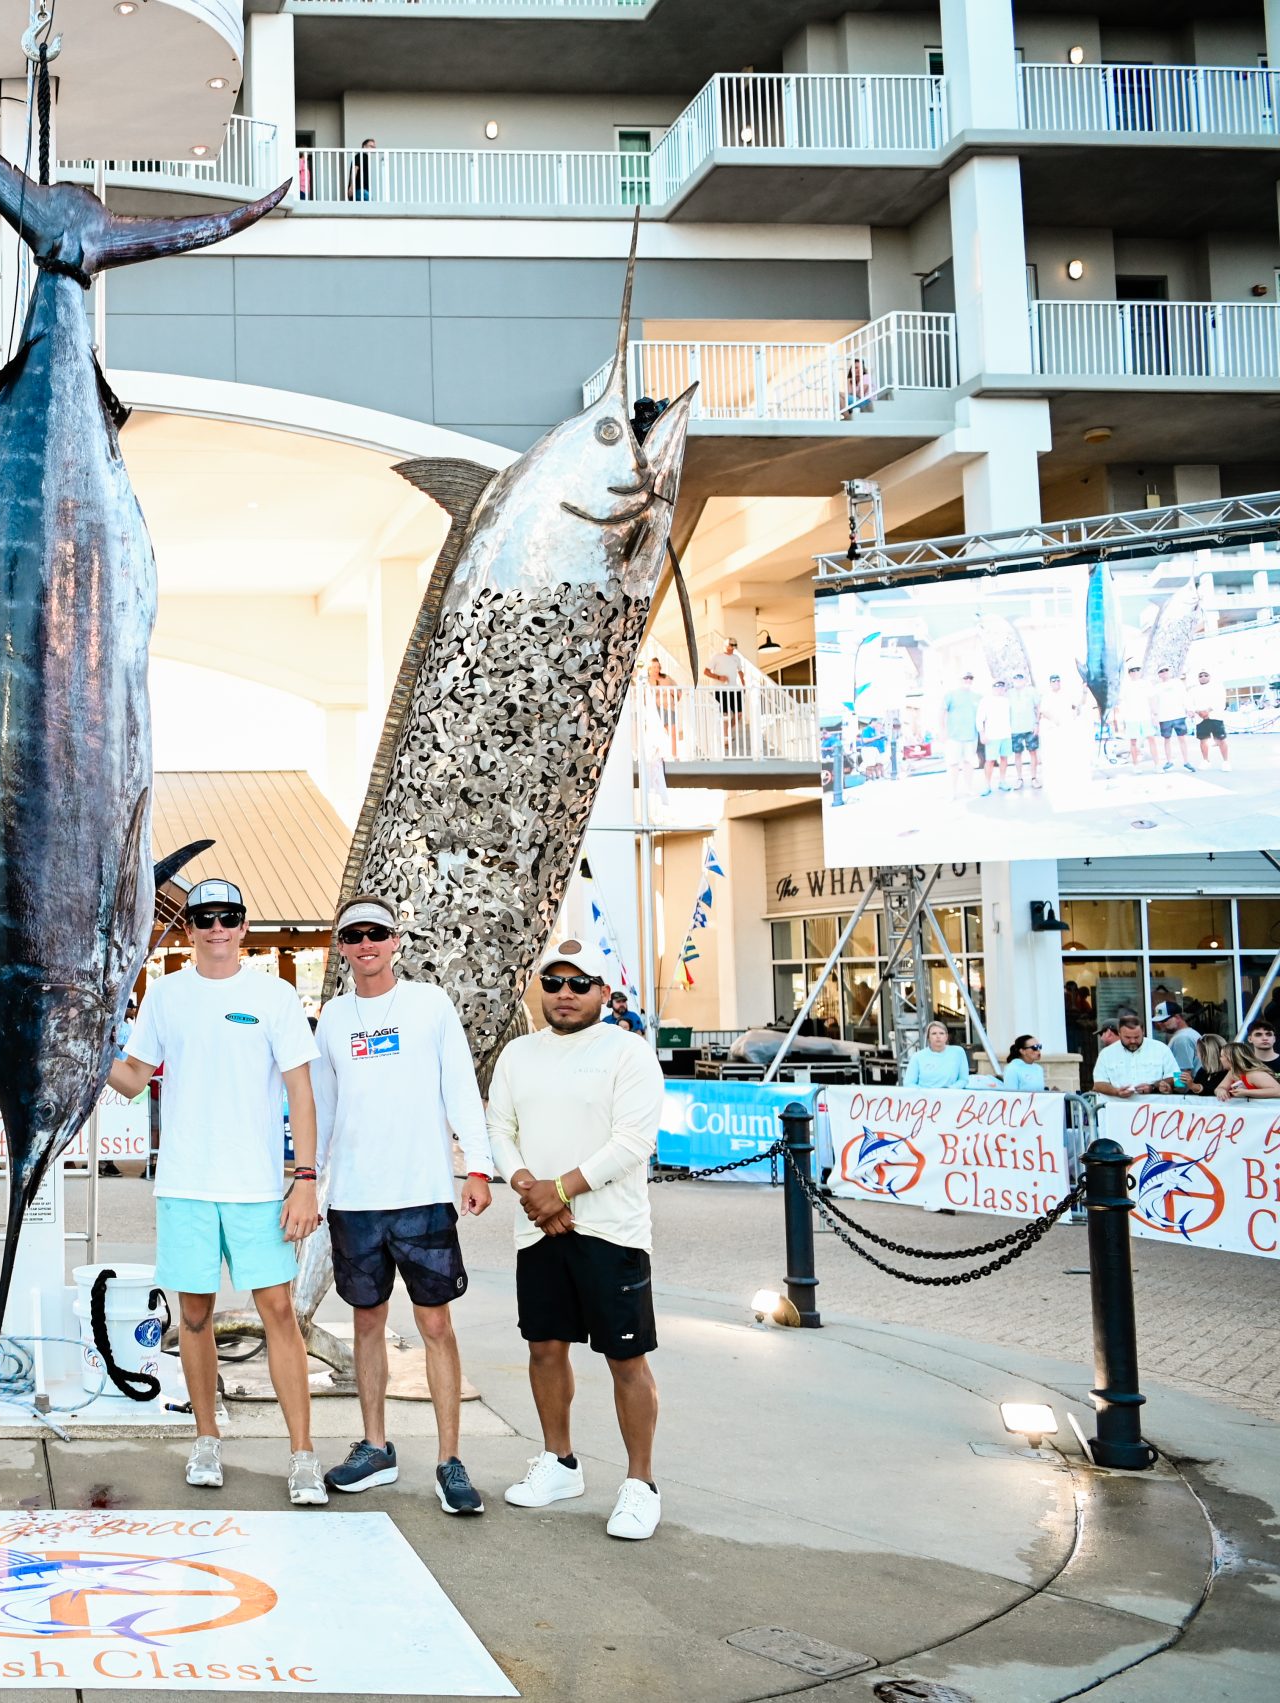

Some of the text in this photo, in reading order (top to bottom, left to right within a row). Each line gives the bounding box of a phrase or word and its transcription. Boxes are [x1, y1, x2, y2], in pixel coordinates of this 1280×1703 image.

[776, 874, 800, 901] The
[350, 1026, 400, 1040] PELAGIC
[849, 1092, 1044, 1139] Orange Beach
[1130, 1104, 1245, 1162] Orange
[63, 1128, 145, 1155] lssic
[938, 1132, 1060, 1174] Billfish
[944, 1170, 1058, 1216] Classic
[88, 1516, 251, 1538] Beach
[92, 1649, 319, 1684] Classic
